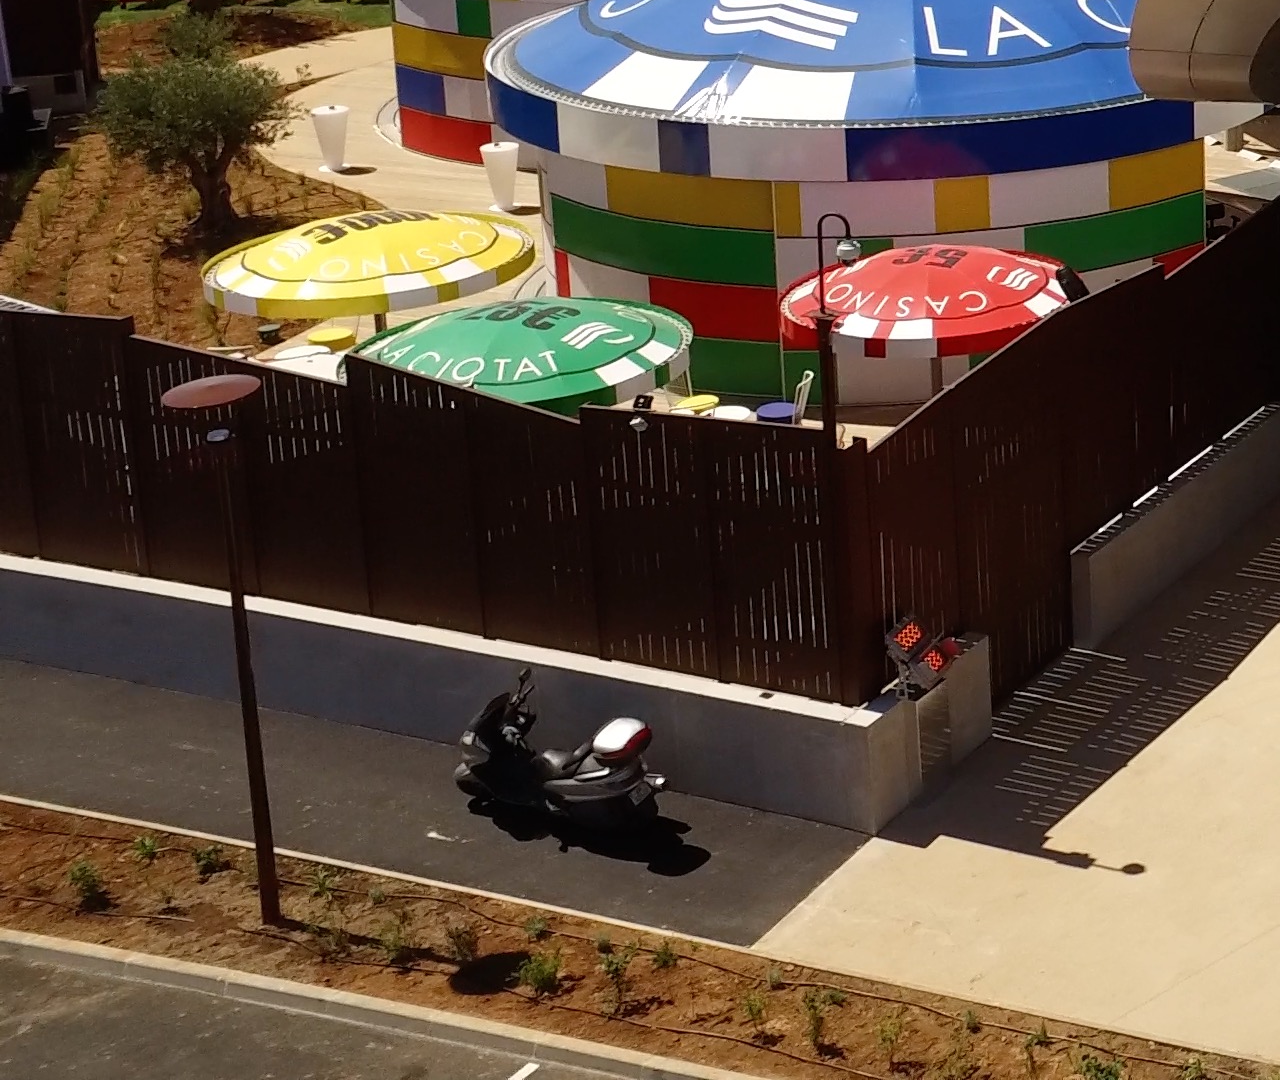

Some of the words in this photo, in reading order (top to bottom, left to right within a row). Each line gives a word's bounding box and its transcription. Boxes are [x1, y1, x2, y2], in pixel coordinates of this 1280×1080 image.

[923, 5, 1053, 57] LA
[320, 231, 489, 280] CASINO
[825, 283, 988, 318] CASINO
[407, 350, 559, 382] CIOTAT
